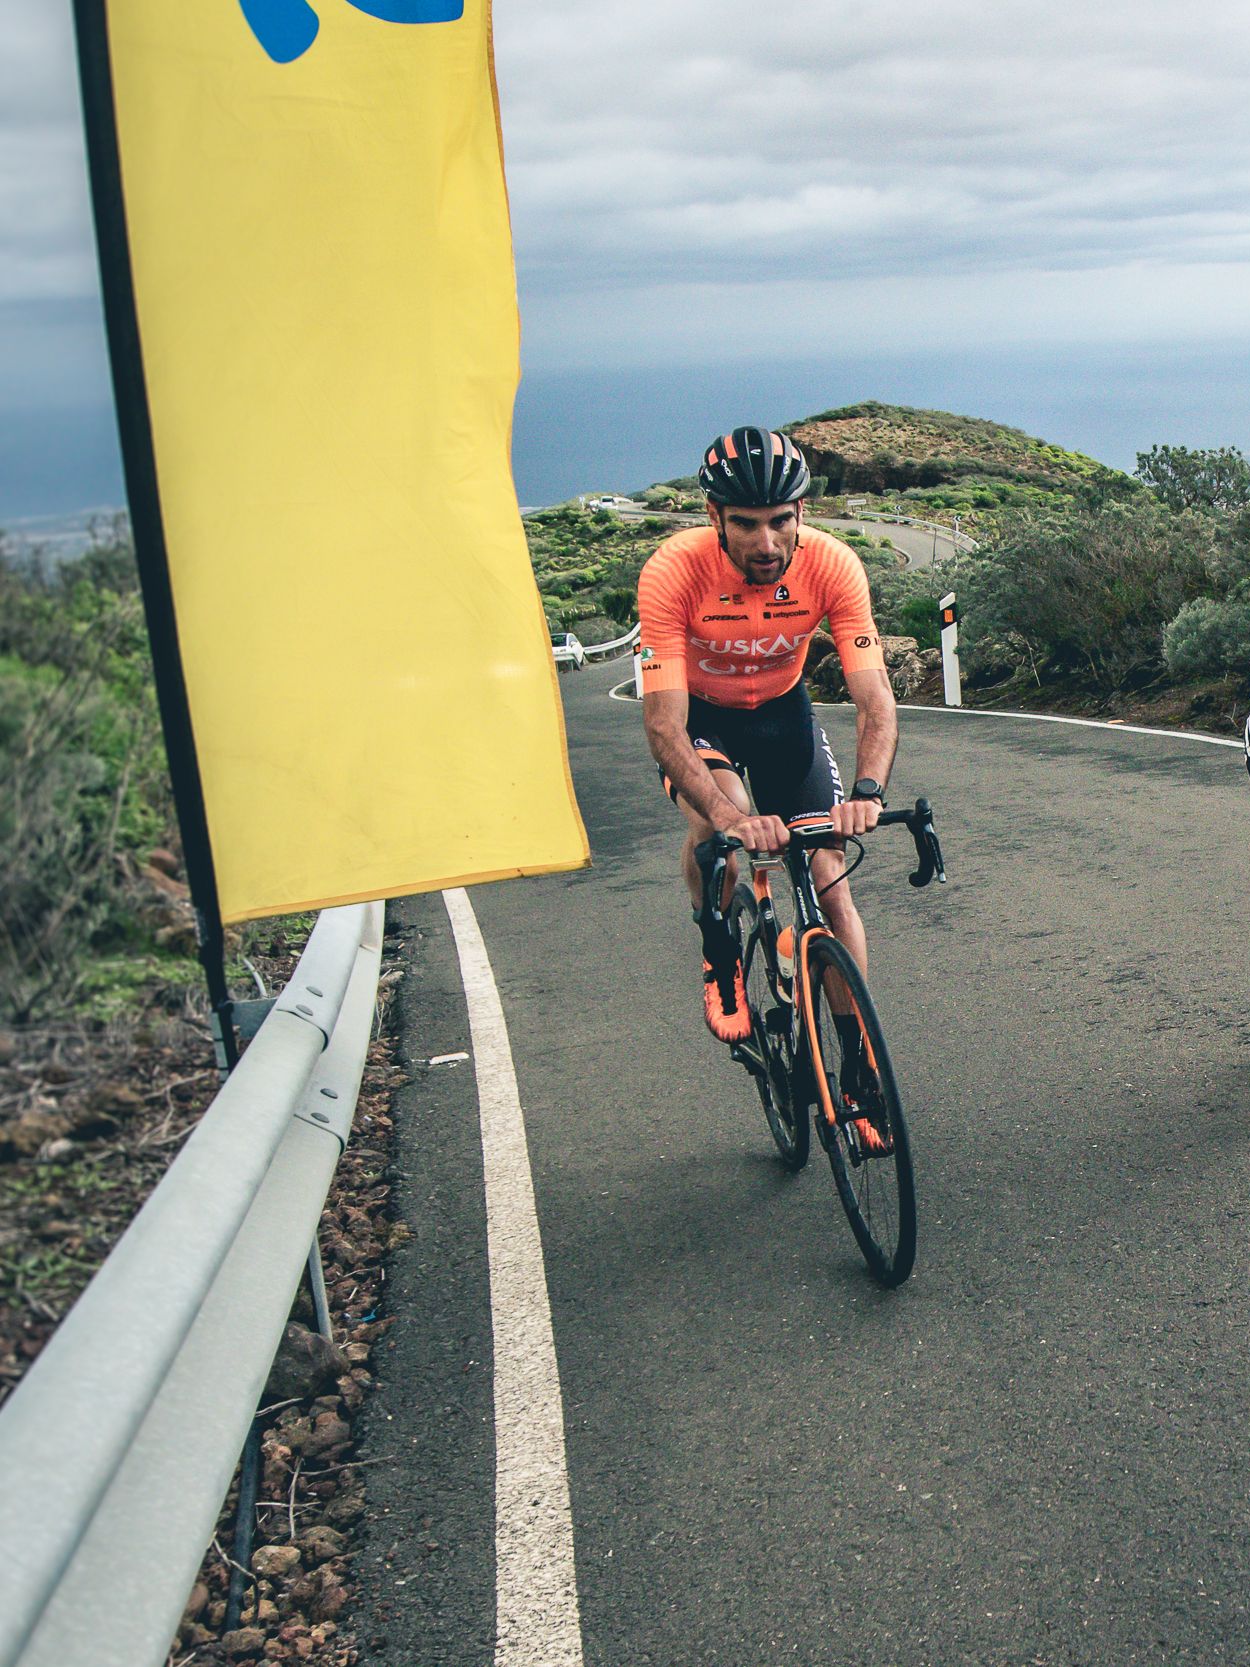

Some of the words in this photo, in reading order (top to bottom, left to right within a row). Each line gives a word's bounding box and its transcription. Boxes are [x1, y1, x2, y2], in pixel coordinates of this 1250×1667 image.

[702, 614, 749, 622] ORBEA
[790, 811, 831, 821] ORBEA
[796, 886, 810, 926] ORBEA
